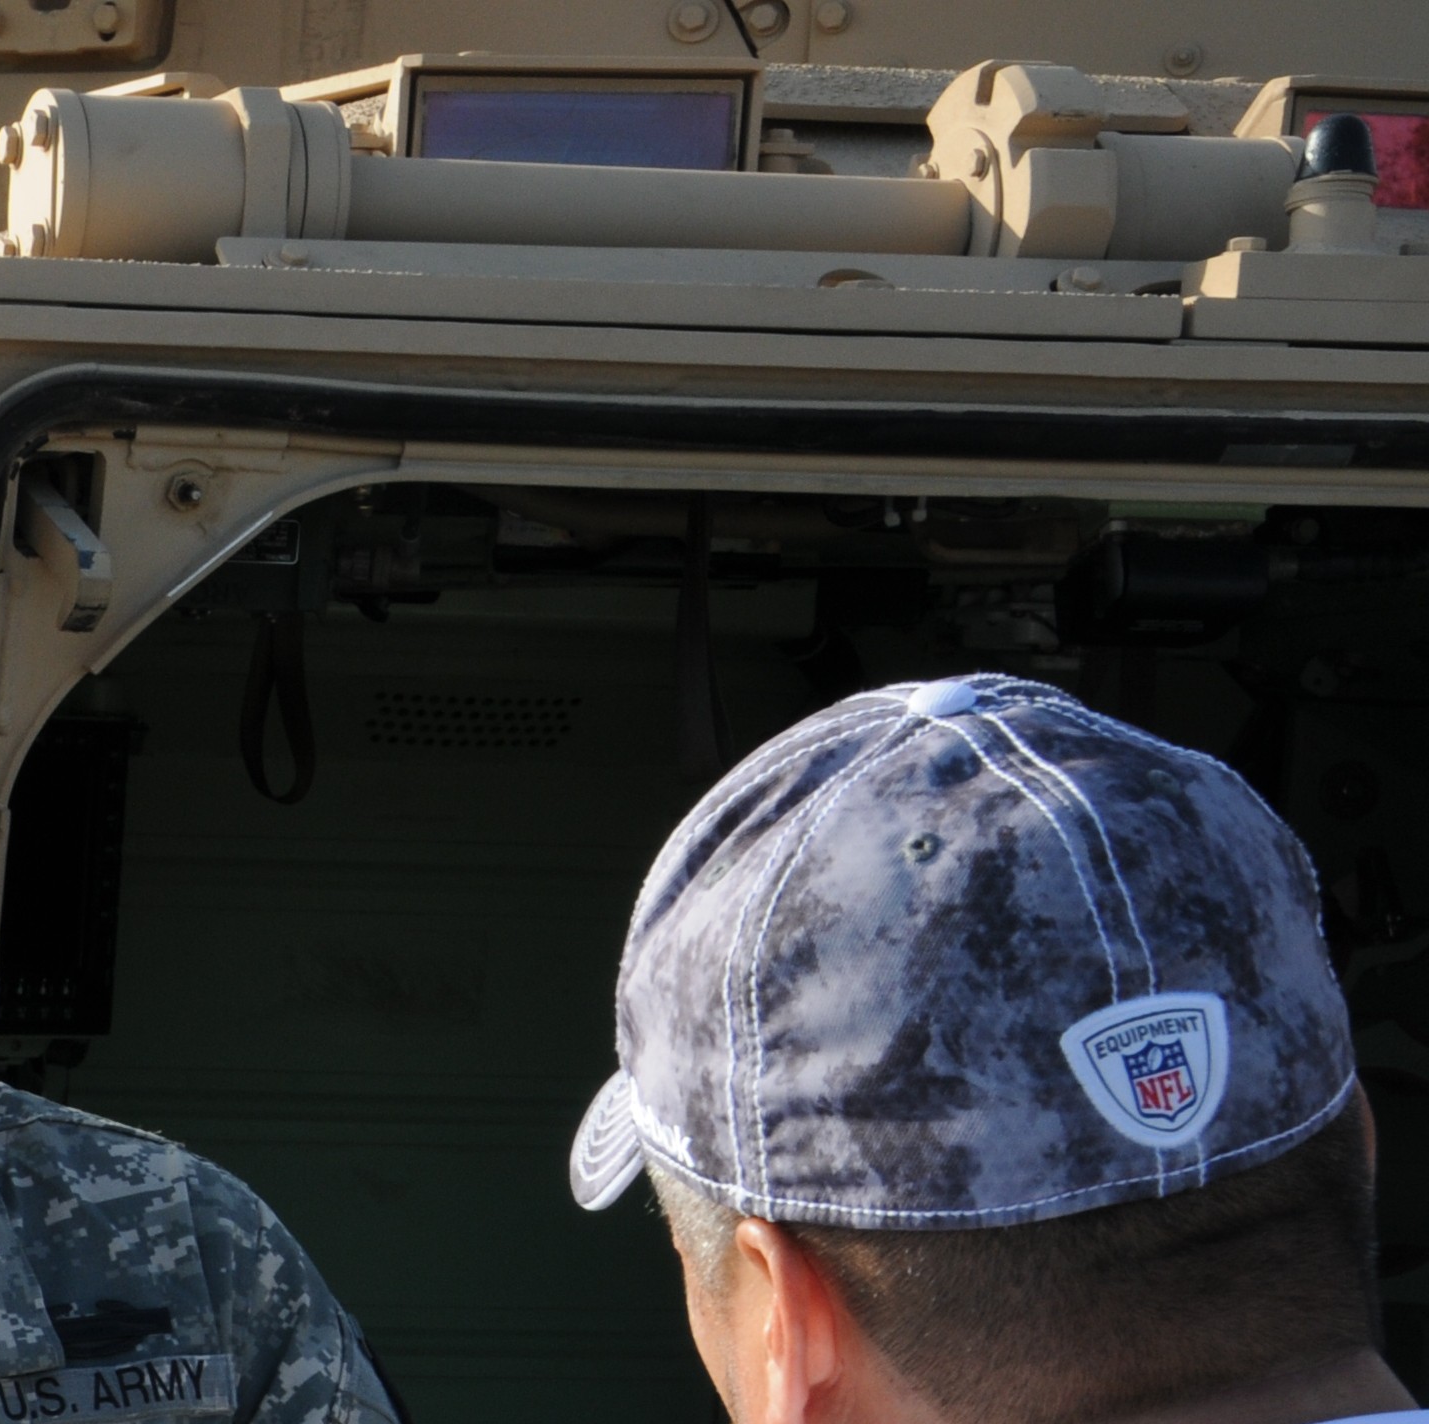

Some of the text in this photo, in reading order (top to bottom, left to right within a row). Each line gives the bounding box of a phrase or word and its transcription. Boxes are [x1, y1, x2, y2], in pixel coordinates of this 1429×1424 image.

[1094, 1016, 1198, 1060] EQUIPMENT
[1136, 1070, 1194, 1111] NFL
[93, 1359, 204, 1411] ARMY
